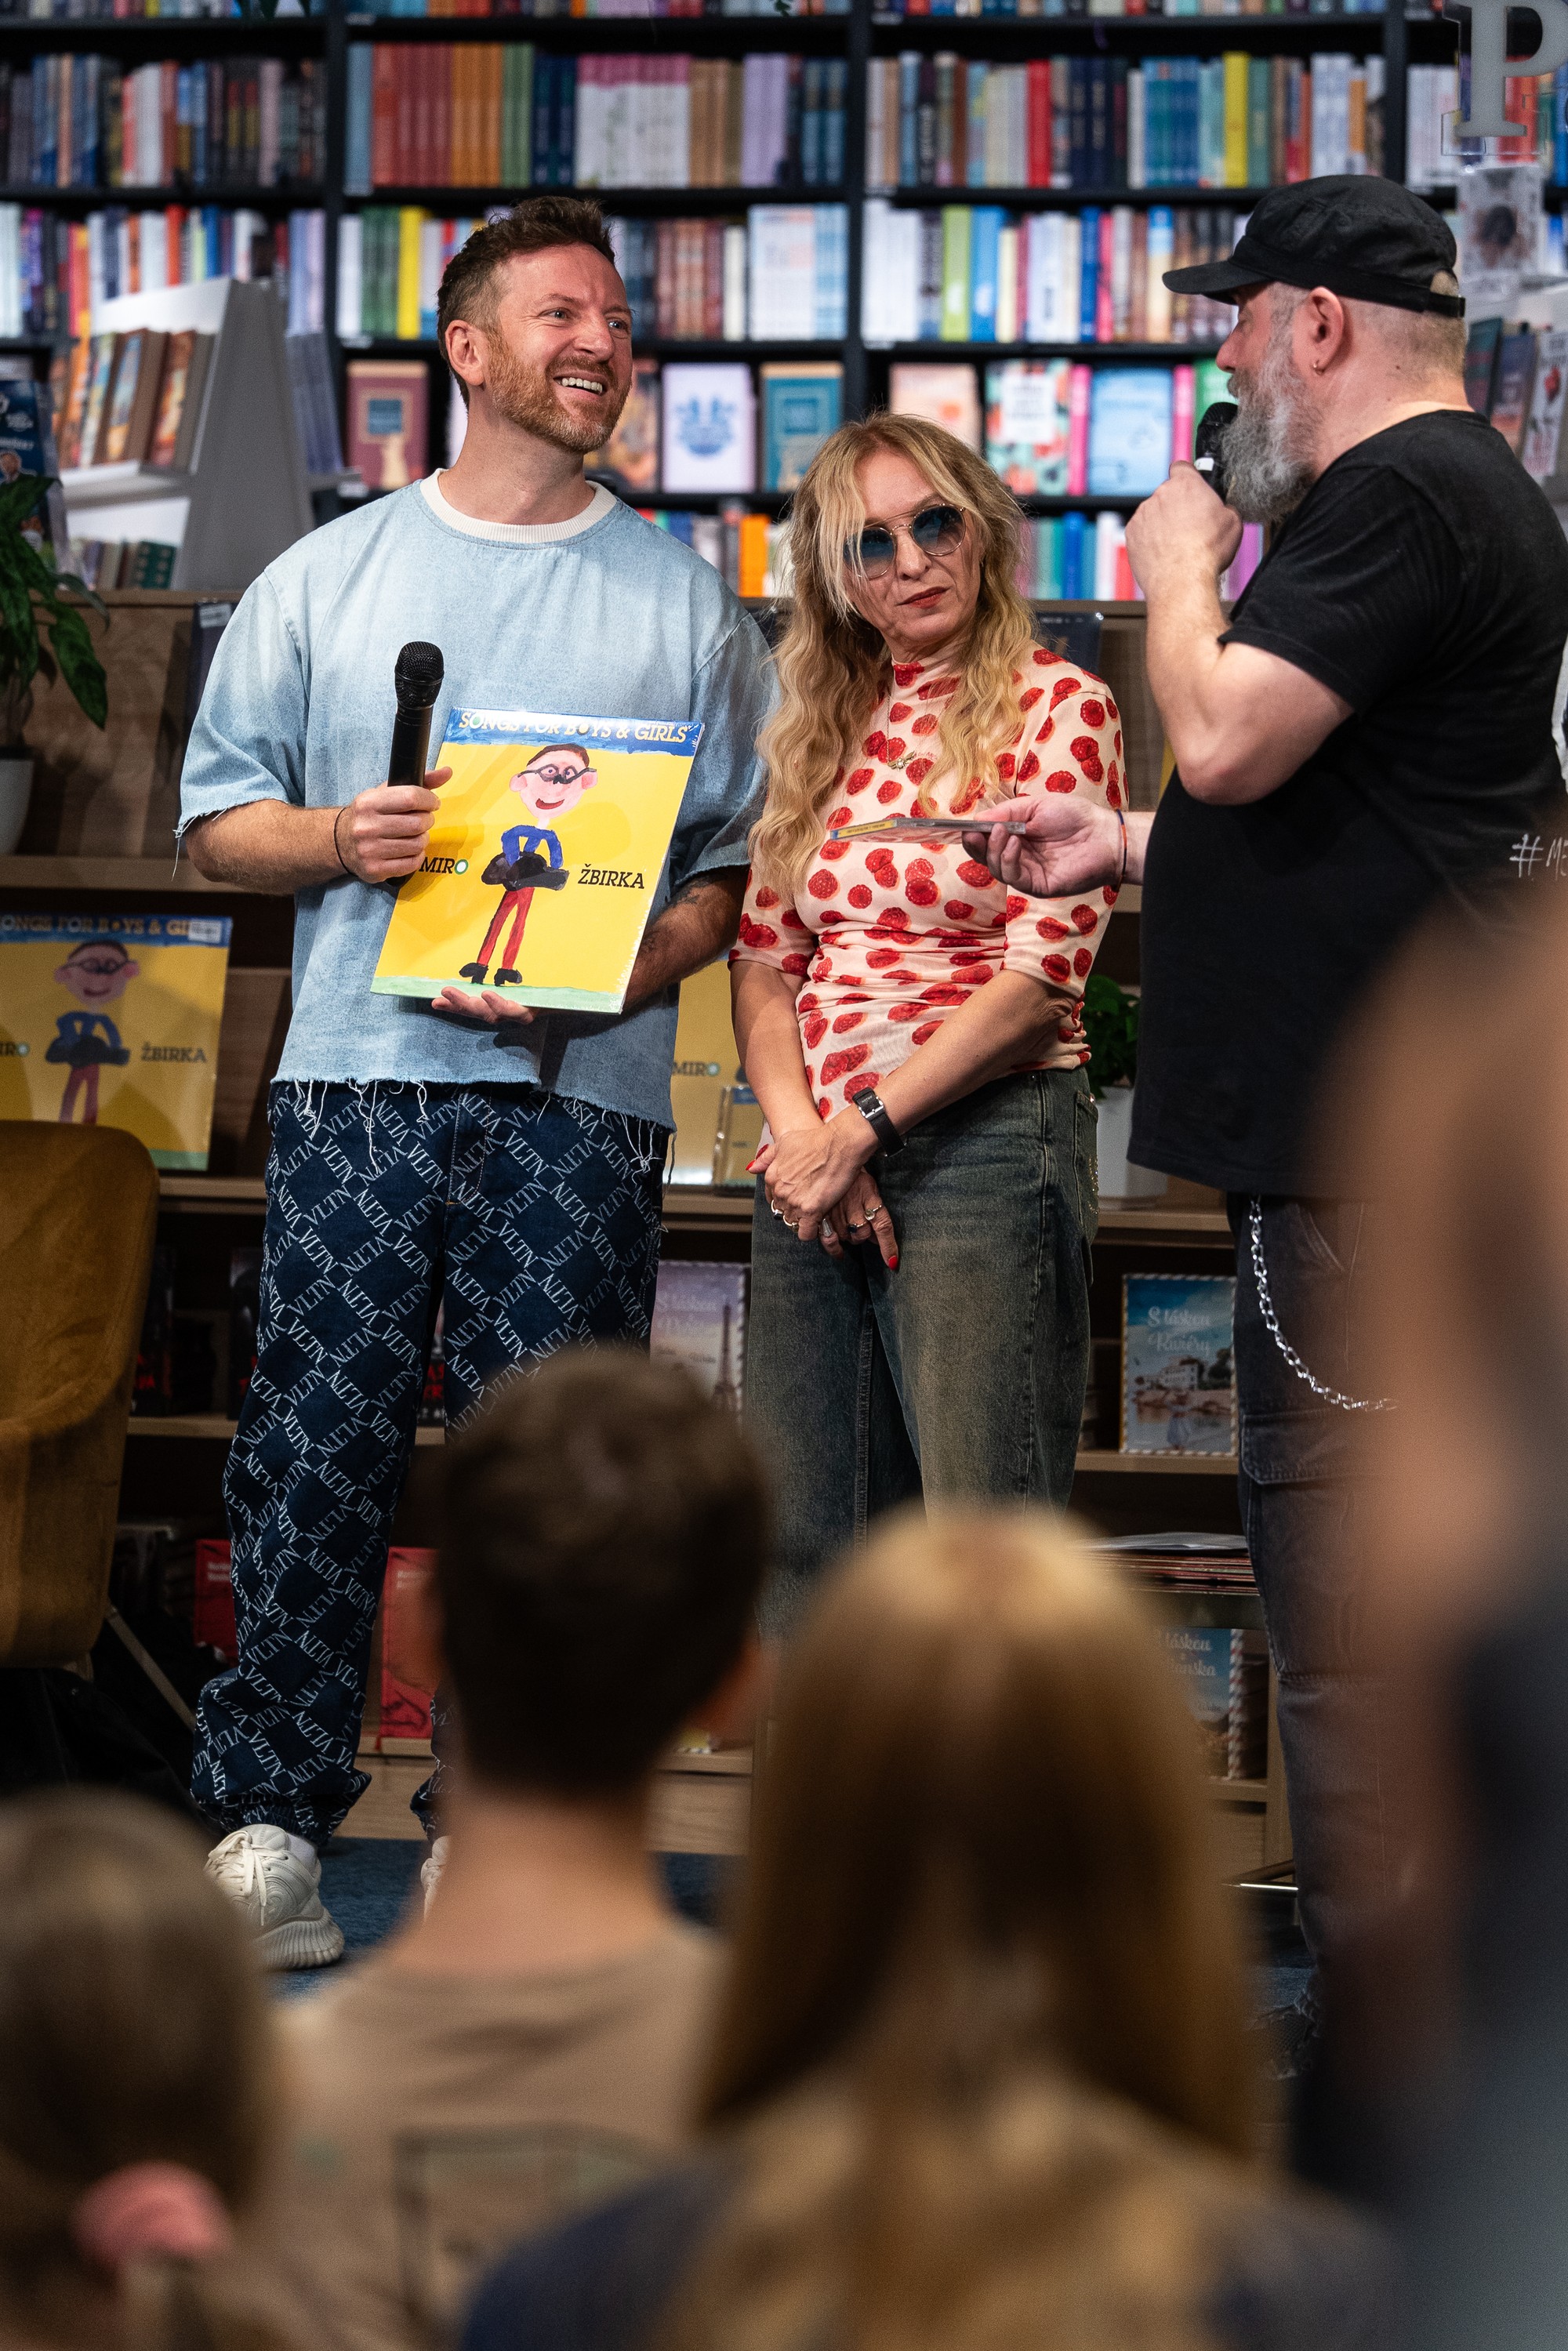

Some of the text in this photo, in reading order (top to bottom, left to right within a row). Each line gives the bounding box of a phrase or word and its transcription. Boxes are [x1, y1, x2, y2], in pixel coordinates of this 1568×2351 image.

[459, 712, 520, 732] SONGS
[564, 720, 604, 738] BOYS
[616, 725, 630, 738] &
[633, 724, 688, 743] GIRLS
[419, 857, 645, 890] MIRO ŽBIRKA
[0, 914, 53, 933] ONGS
[0, 1041, 208, 1063] IRO ŽBIRKA
[321, 1099, 370, 1135] VLTN
[373, 1098, 410, 1146] VLTN
[412, 1097, 461, 1140] VLTN
[280, 1140, 320, 1181] VLTN
[320, 1137, 356, 1184] VLTN
[358, 1145, 408, 1186] VLTN
[408, 1141, 447, 1188] VLTN
[452, 1136, 504, 1179] VLTN
[504, 1130, 549, 1177] VLTN
[552, 1137, 600, 1180] VLTN
[601, 1135, 633, 1181] VLTN
[278, 1184, 302, 1230] VLTN
[303, 1185, 352, 1225] VLTN
[354, 1188, 393, 1236] VLTN
[394, 1190, 444, 1232] VLTN
[452, 1181, 495, 1224] VLTN
[497, 1177, 547, 1219] VLTN
[549, 1181, 590, 1229] VLTN
[593, 1183, 632, 1224] VLTN
[299, 1226, 339, 1275] VLTN
[339, 1235, 394, 1277] VLTN
[393, 1232, 432, 1279] VLTN
[448, 1224, 498, 1266] VLTN
[498, 1219, 538, 1268] VLTN
[540, 1230, 590, 1272] VLTN
[590, 1225, 619, 1273] VLTN
[287, 1274, 336, 1316] VLTN
[338, 1279, 379, 1327] VLTN
[382, 1277, 430, 1321] VLTN
[447, 1267, 491, 1313] VLTN
[493, 1269, 536, 1309] VLTN
[539, 1273, 579, 1322] VLTN
[288, 1317, 328, 1365] VLTN
[329, 1326, 381, 1368] VLTN
[382, 1322, 421, 1368] VLTN
[446, 1312, 494, 1352] VLTN
[494, 1309, 528, 1360] VLTN
[529, 1322, 577, 1363] VLTN
[283, 1366, 325, 1406] VLTN
[327, 1370, 369, 1417] VLTN
[372, 1366, 417, 1409] VLTN
[447, 1354, 485, 1401] VLTN
[241, 1410, 283, 1449] VLTN
[283, 1406, 314, 1455] VLTN
[317, 1417, 369, 1459] VLTN
[243, 1452, 277, 1495] VLTN
[280, 1457, 311, 1493] VLTN
[314, 1460, 356, 1503] VLTN
[305, 1504, 355, 1545] VLTN
[304, 1547, 343, 1585] VLTN
[296, 1587, 343, 1628] VLTN
[246, 1630, 292, 1665] VLTN
[295, 1631, 335, 1668] VLTN
[290, 1670, 335, 1707] VLTN
[249, 1702, 290, 1729] VLTN
[292, 1711, 333, 1753] VLTN
[249, 1729, 288, 1781] VLTN
[288, 1752, 336, 1786] VLTN
